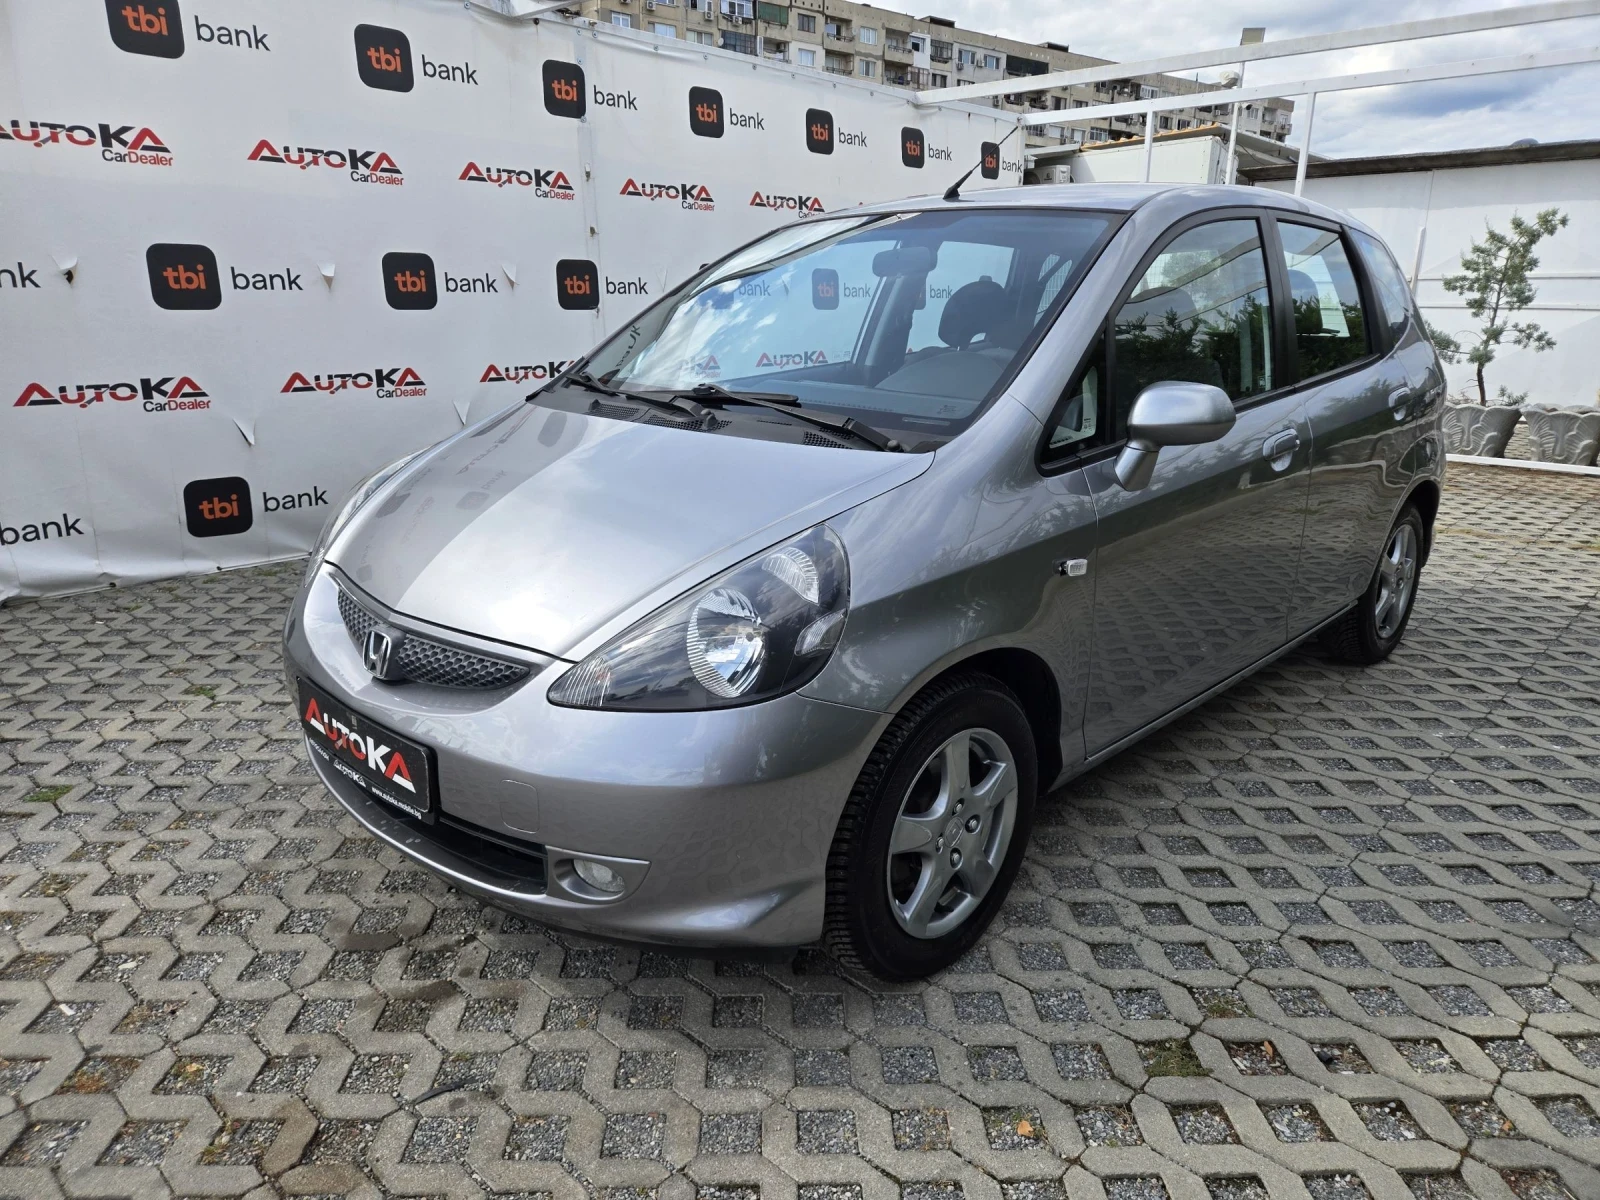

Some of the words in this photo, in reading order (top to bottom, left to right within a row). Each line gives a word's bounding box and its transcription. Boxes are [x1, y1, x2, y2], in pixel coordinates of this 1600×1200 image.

[122, 4, 169, 36] tbi
[194, 15, 271, 52] bank
[367, 46, 402, 73] tbi
[421, 54, 479, 86] bank
[551, 79, 578, 102] tbi
[593, 85, 638, 111] bank
[696, 104, 718, 123] tbi
[729, 108, 765, 131] bank
[0, 119, 172, 153] UTOKA
[811, 124, 829, 142] tbi
[838, 127, 868, 148] bank
[101, 148, 173, 167] CarDealer
[905, 140, 920, 157] tbi
[928, 143, 953, 162] bank
[1002, 156, 1023, 174] bank
[350, 170, 404, 186] CarDealer
[535, 187, 575, 201] CarDealer
[681, 200, 715, 212] CarDealer
[0, 262, 42, 288] nk
[162, 264, 207, 290] tbi
[230, 266, 303, 291] bank
[394, 270, 427, 293] tbi
[444, 272, 499, 294] bank
[564, 274, 591, 295] tbi
[605, 276, 649, 295] bank
[843, 283, 872, 298] bank
[479, 360, 575, 384] AUTOK
[376, 386, 427, 399] CarDealer
[142, 398, 211, 413] CarDealer
[198, 493, 240, 520] tbi
[262, 485, 329, 513] bank
[0, 512, 85, 546] bank
